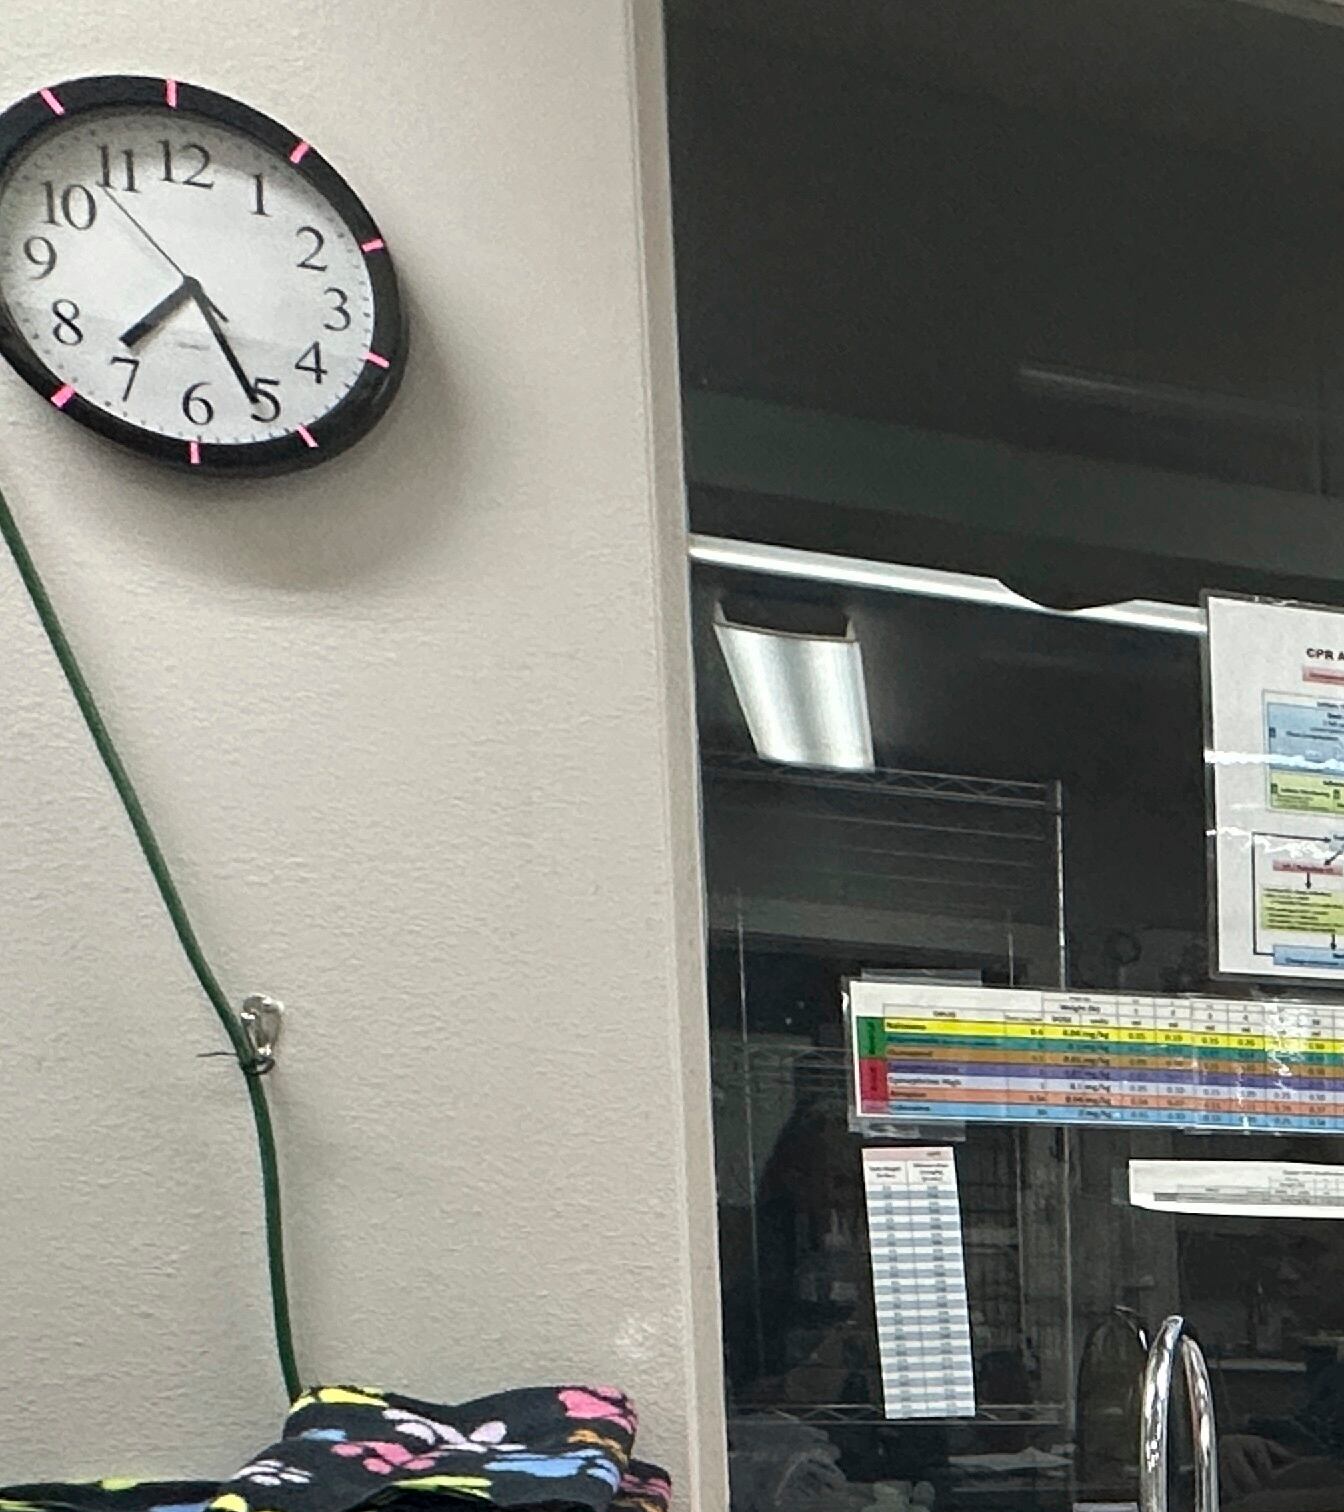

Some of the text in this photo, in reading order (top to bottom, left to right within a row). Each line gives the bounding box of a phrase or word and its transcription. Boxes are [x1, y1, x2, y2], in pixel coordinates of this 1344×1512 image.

[97, 144, 141, 193] 11
[159, 139, 214, 190] 12
[41, 181, 97, 230] 10
[250, 173, 272, 217] 1
[23, 236, 57, 280] 9
[295, 226, 328, 272] 2
[52, 299, 84, 346] 8
[323, 287, 352, 331] 3
[110, 356, 140, 402] 7
[295, 341, 328, 384] 4
[182, 382, 214, 425] 6
[251, 377, 281, 422] 5
[1306, 648, 1334, 660] CPR
